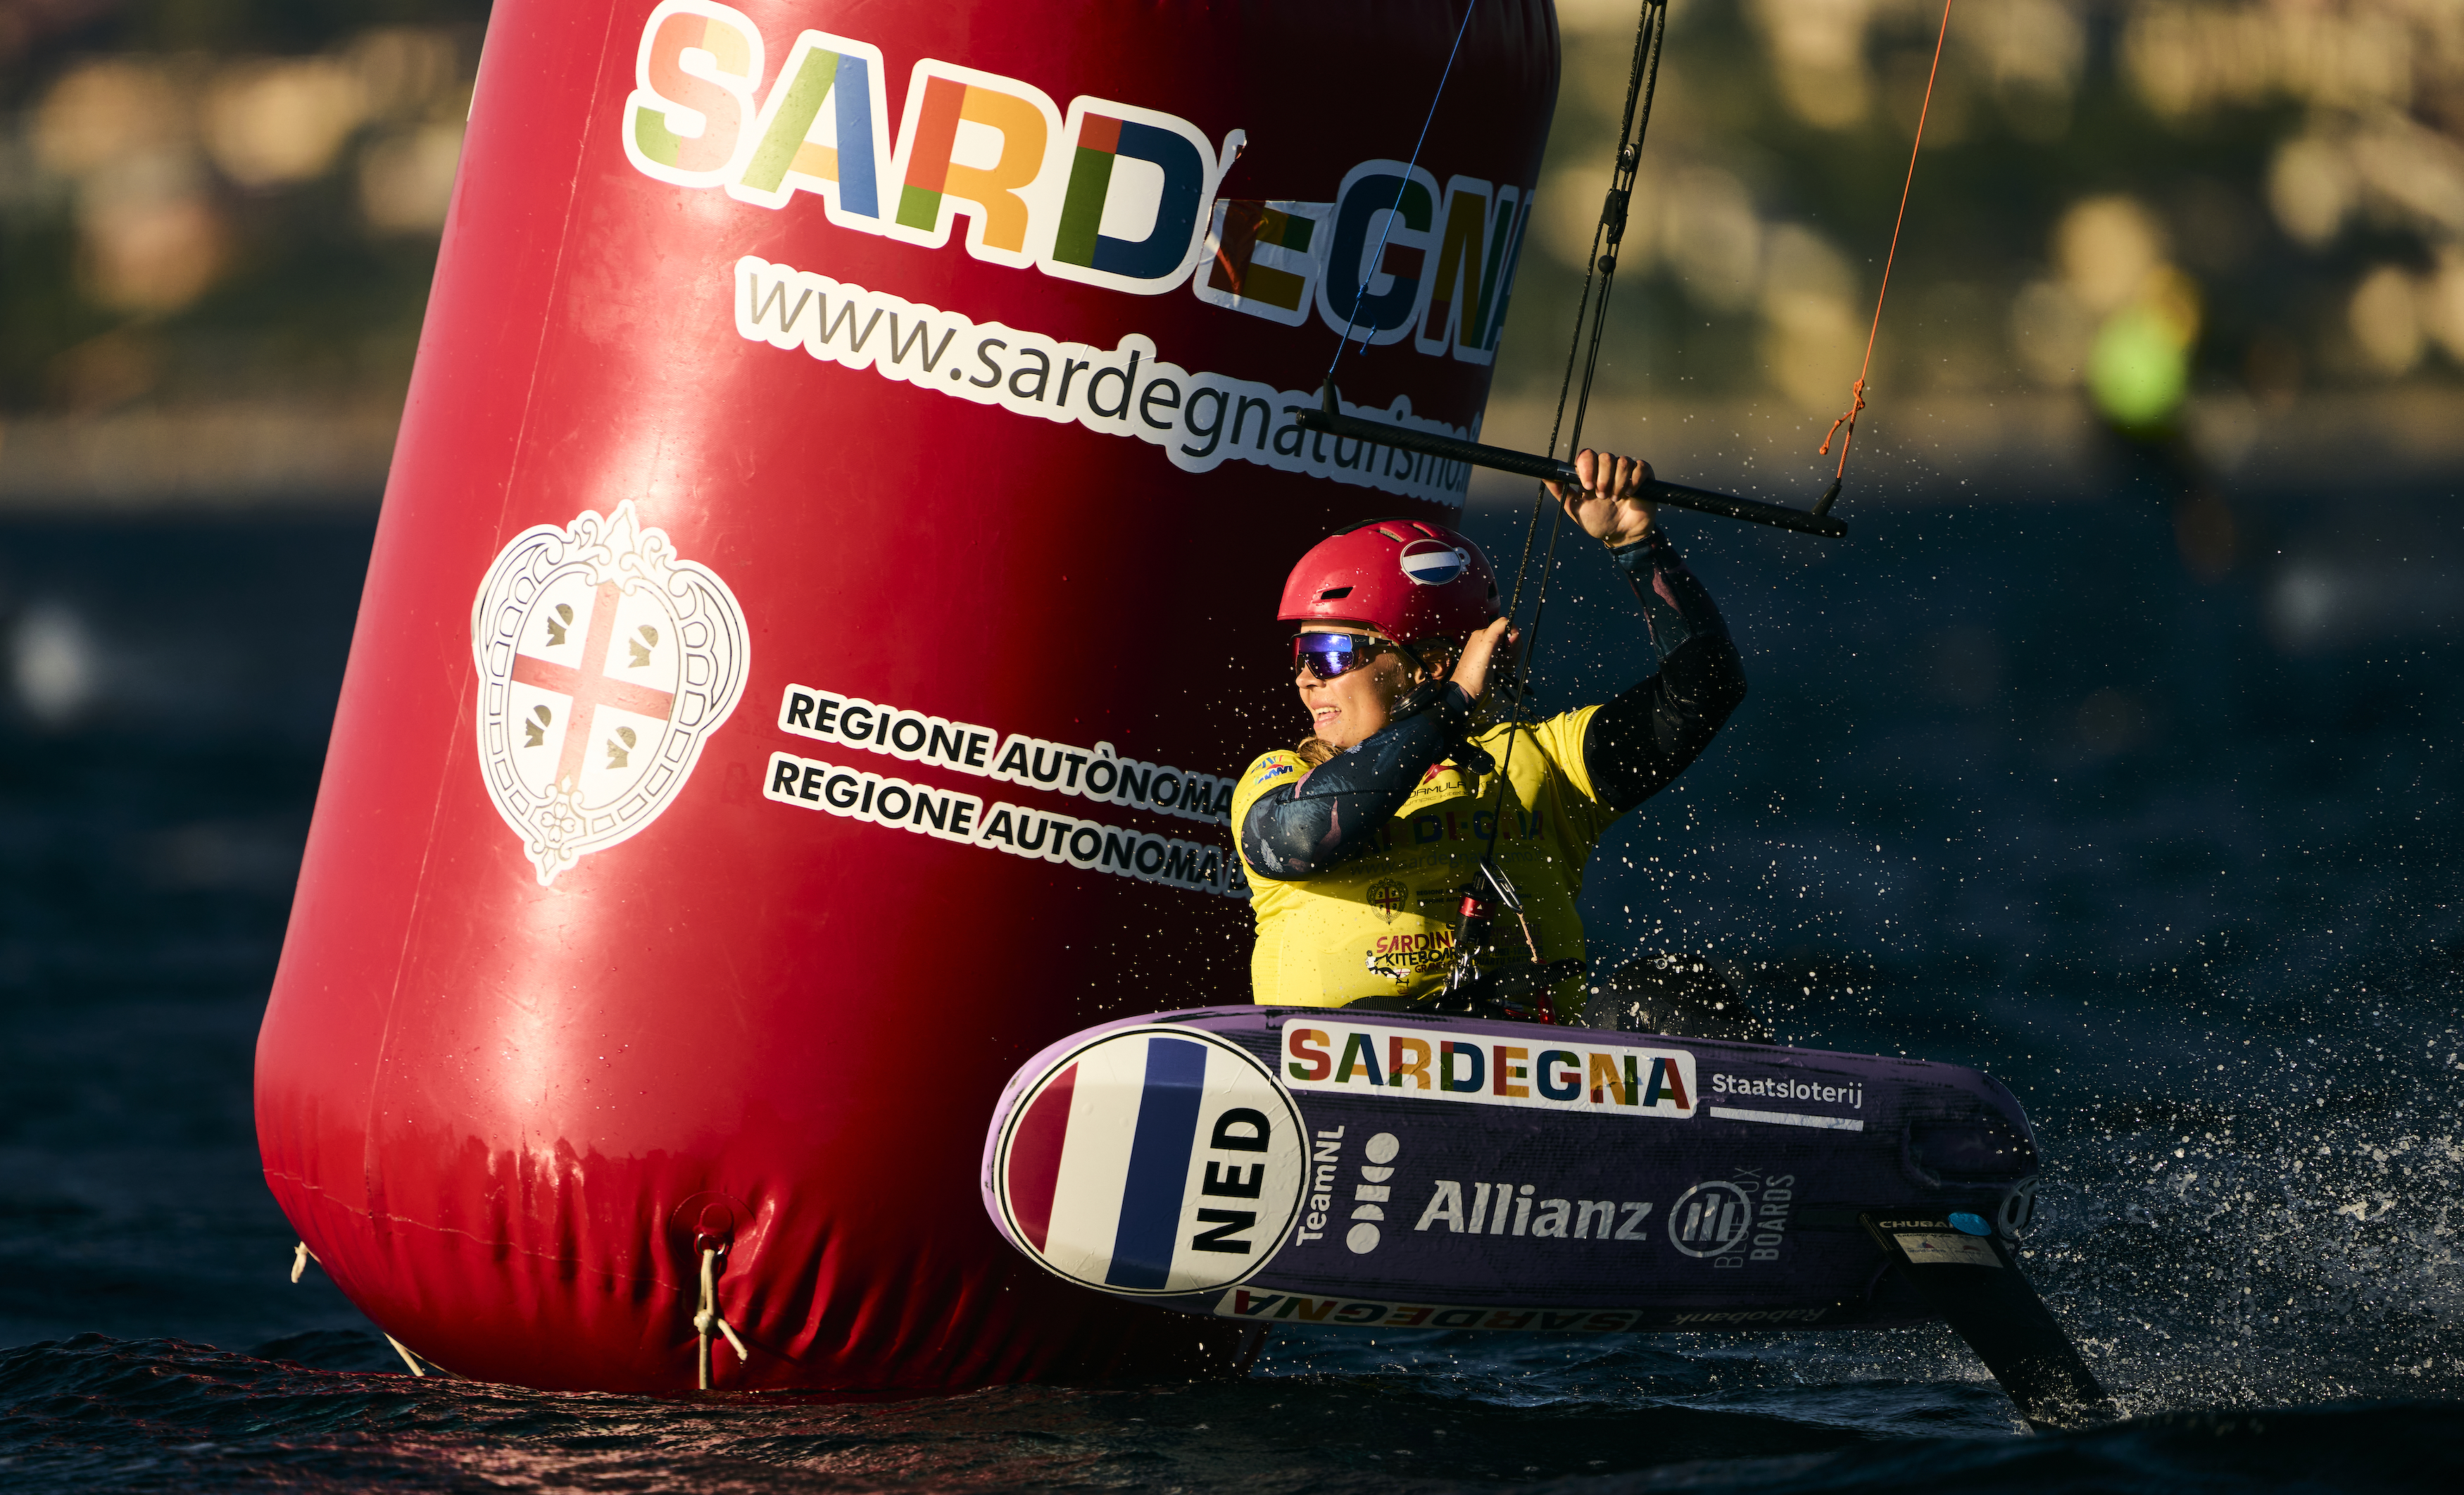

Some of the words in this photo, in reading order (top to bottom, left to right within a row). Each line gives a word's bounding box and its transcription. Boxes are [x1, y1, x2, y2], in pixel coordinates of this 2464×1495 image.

[786, 692, 990, 768] REGIONE
[998, 742, 1233, 819] AUTÒNOMA
[772, 761, 975, 836] REGIONE
[981, 809, 1219, 886] AUTONOMA
[1289, 1028, 1690, 1110] SARDEGNA
[1711, 1072, 1863, 1109] Staatsloterij
[1191, 1108, 1271, 1254] NED
[1295, 1125, 1345, 1246] TeamNL
[1414, 1180, 1653, 1241] Allianz
[1749, 1174, 1795, 1261] BOARDS
[1234, 1289, 1635, 1332] SARDEGNA
[1668, 1307, 1828, 1326] Rabobank
